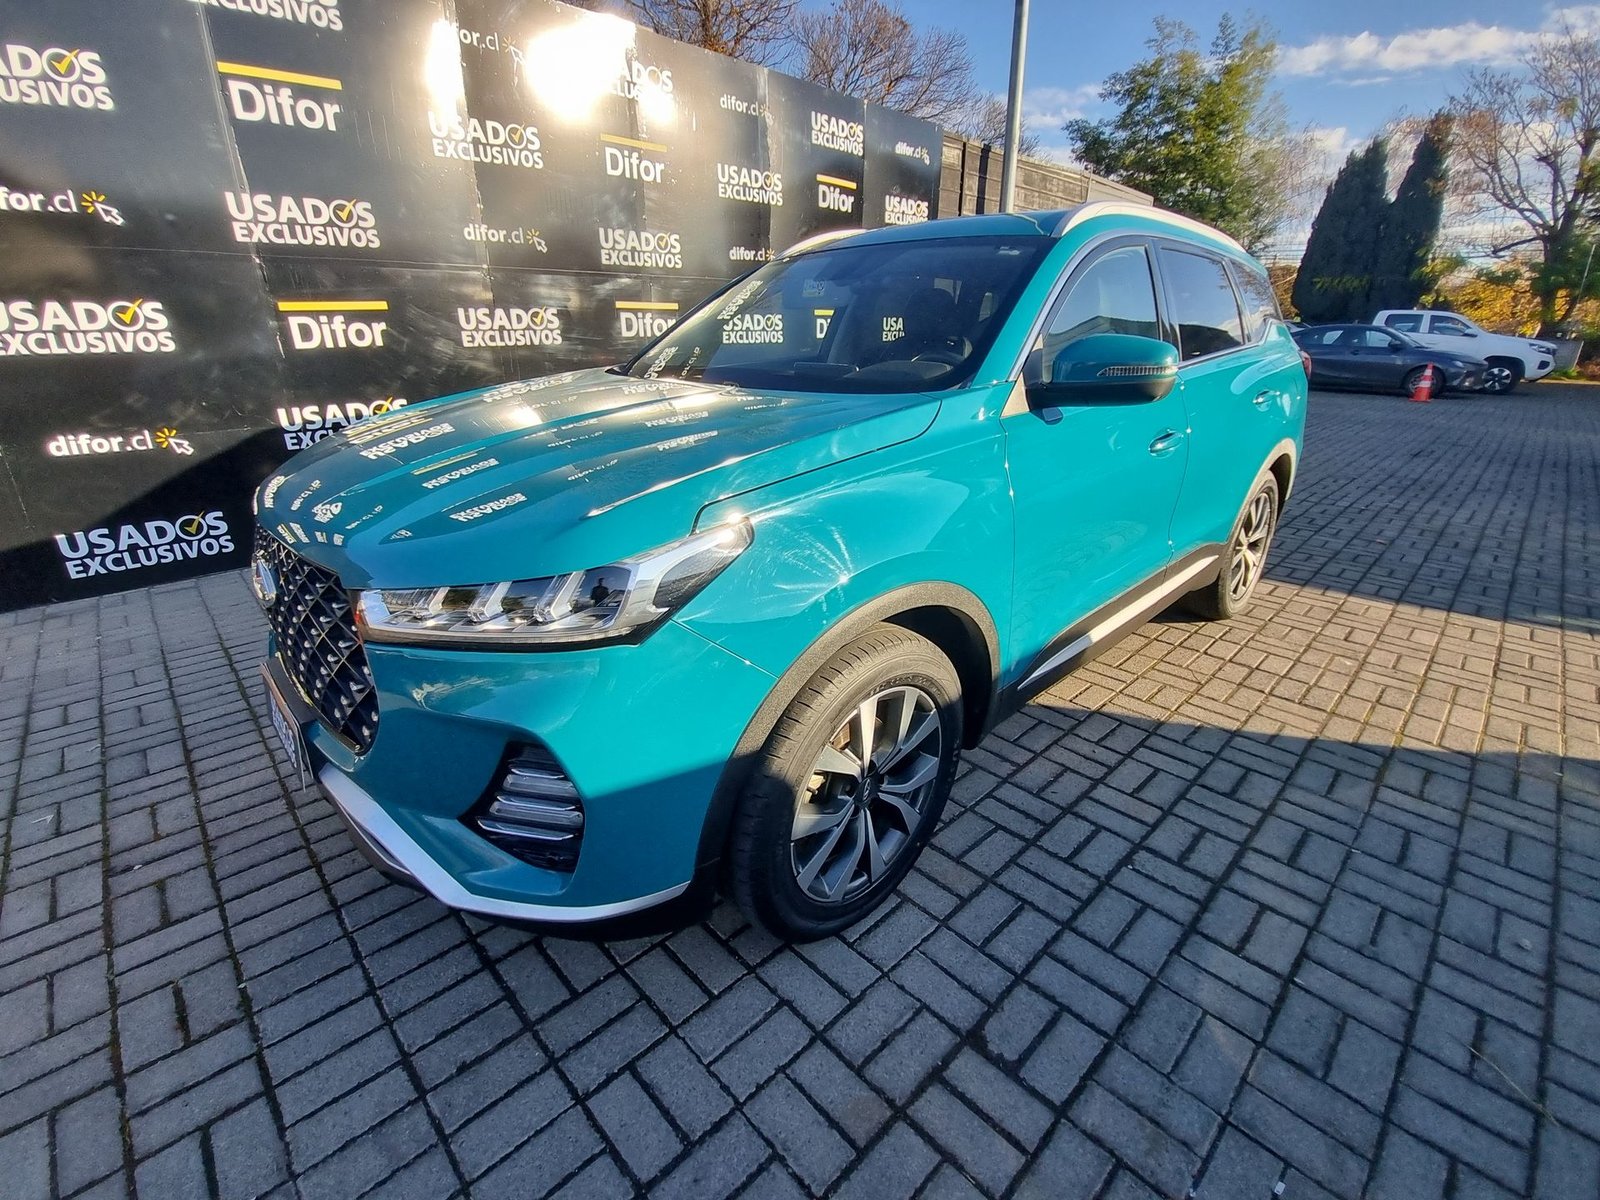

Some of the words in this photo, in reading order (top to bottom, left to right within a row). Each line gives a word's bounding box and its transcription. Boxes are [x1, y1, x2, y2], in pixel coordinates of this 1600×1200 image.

[227, 79, 341, 131] Difor
[720, 94, 760, 117] difor.cl
[428, 111, 541, 150] USADOS
[811, 111, 864, 143] USADOS
[432, 138, 544, 170] EXCLUSIVOS
[811, 131, 864, 157] EXCLUSIVOS
[895, 141, 922, 159] difor.cl
[604, 147, 665, 184] Difor
[717, 163, 783, 192] USADOS
[718, 183, 784, 207] EXCLUSIVOS
[818, 184, 855, 213] Difor
[885, 194, 929, 217] USADOS
[225, 191, 376, 229] USADOS
[233, 221, 381, 249] EXCLUSIVOS
[463, 223, 524, 245] difor.cl
[599, 227, 681, 253] USADOS
[600, 249, 683, 269] EXCLUSIVOS
[729, 247, 766, 262] difor.cl
[287, 315, 387, 350] Difor
[457, 307, 560, 331] USADOS
[460, 329, 562, 348] EXCLUSIVOS
[722, 331, 784, 344] EXCLUSIVOS
[47, 430, 153, 458] difor.cl
[55, 511, 228, 559] USADOS
[65, 534, 235, 580] EXCLUSIVOS
